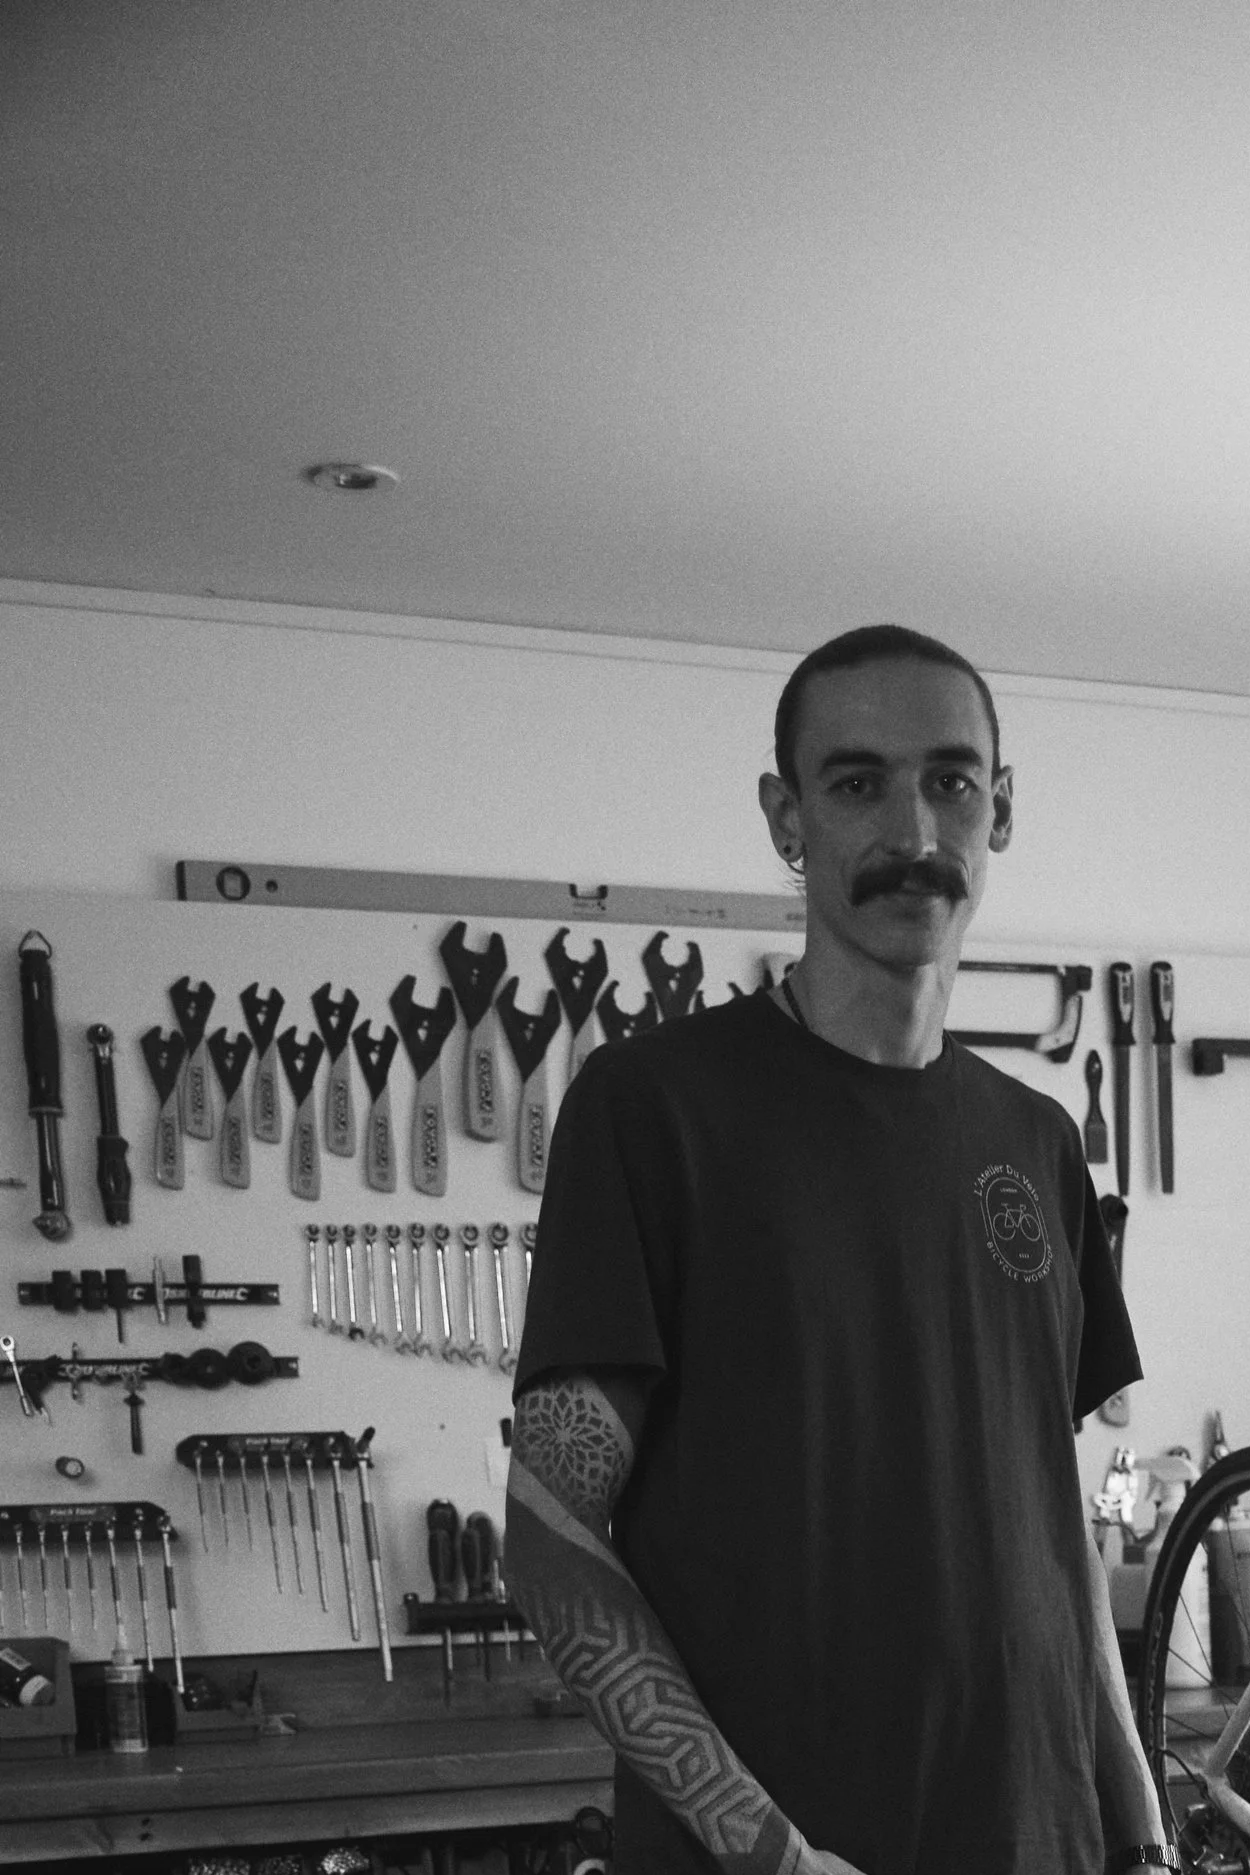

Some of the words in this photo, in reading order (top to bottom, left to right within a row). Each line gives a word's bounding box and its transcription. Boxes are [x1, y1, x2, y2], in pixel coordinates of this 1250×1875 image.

[1005, 1164, 1019, 1179] Du
[986, 1240, 1019, 1281] BICYCLE
[1023, 1243, 1054, 1283] WORKSHOP
